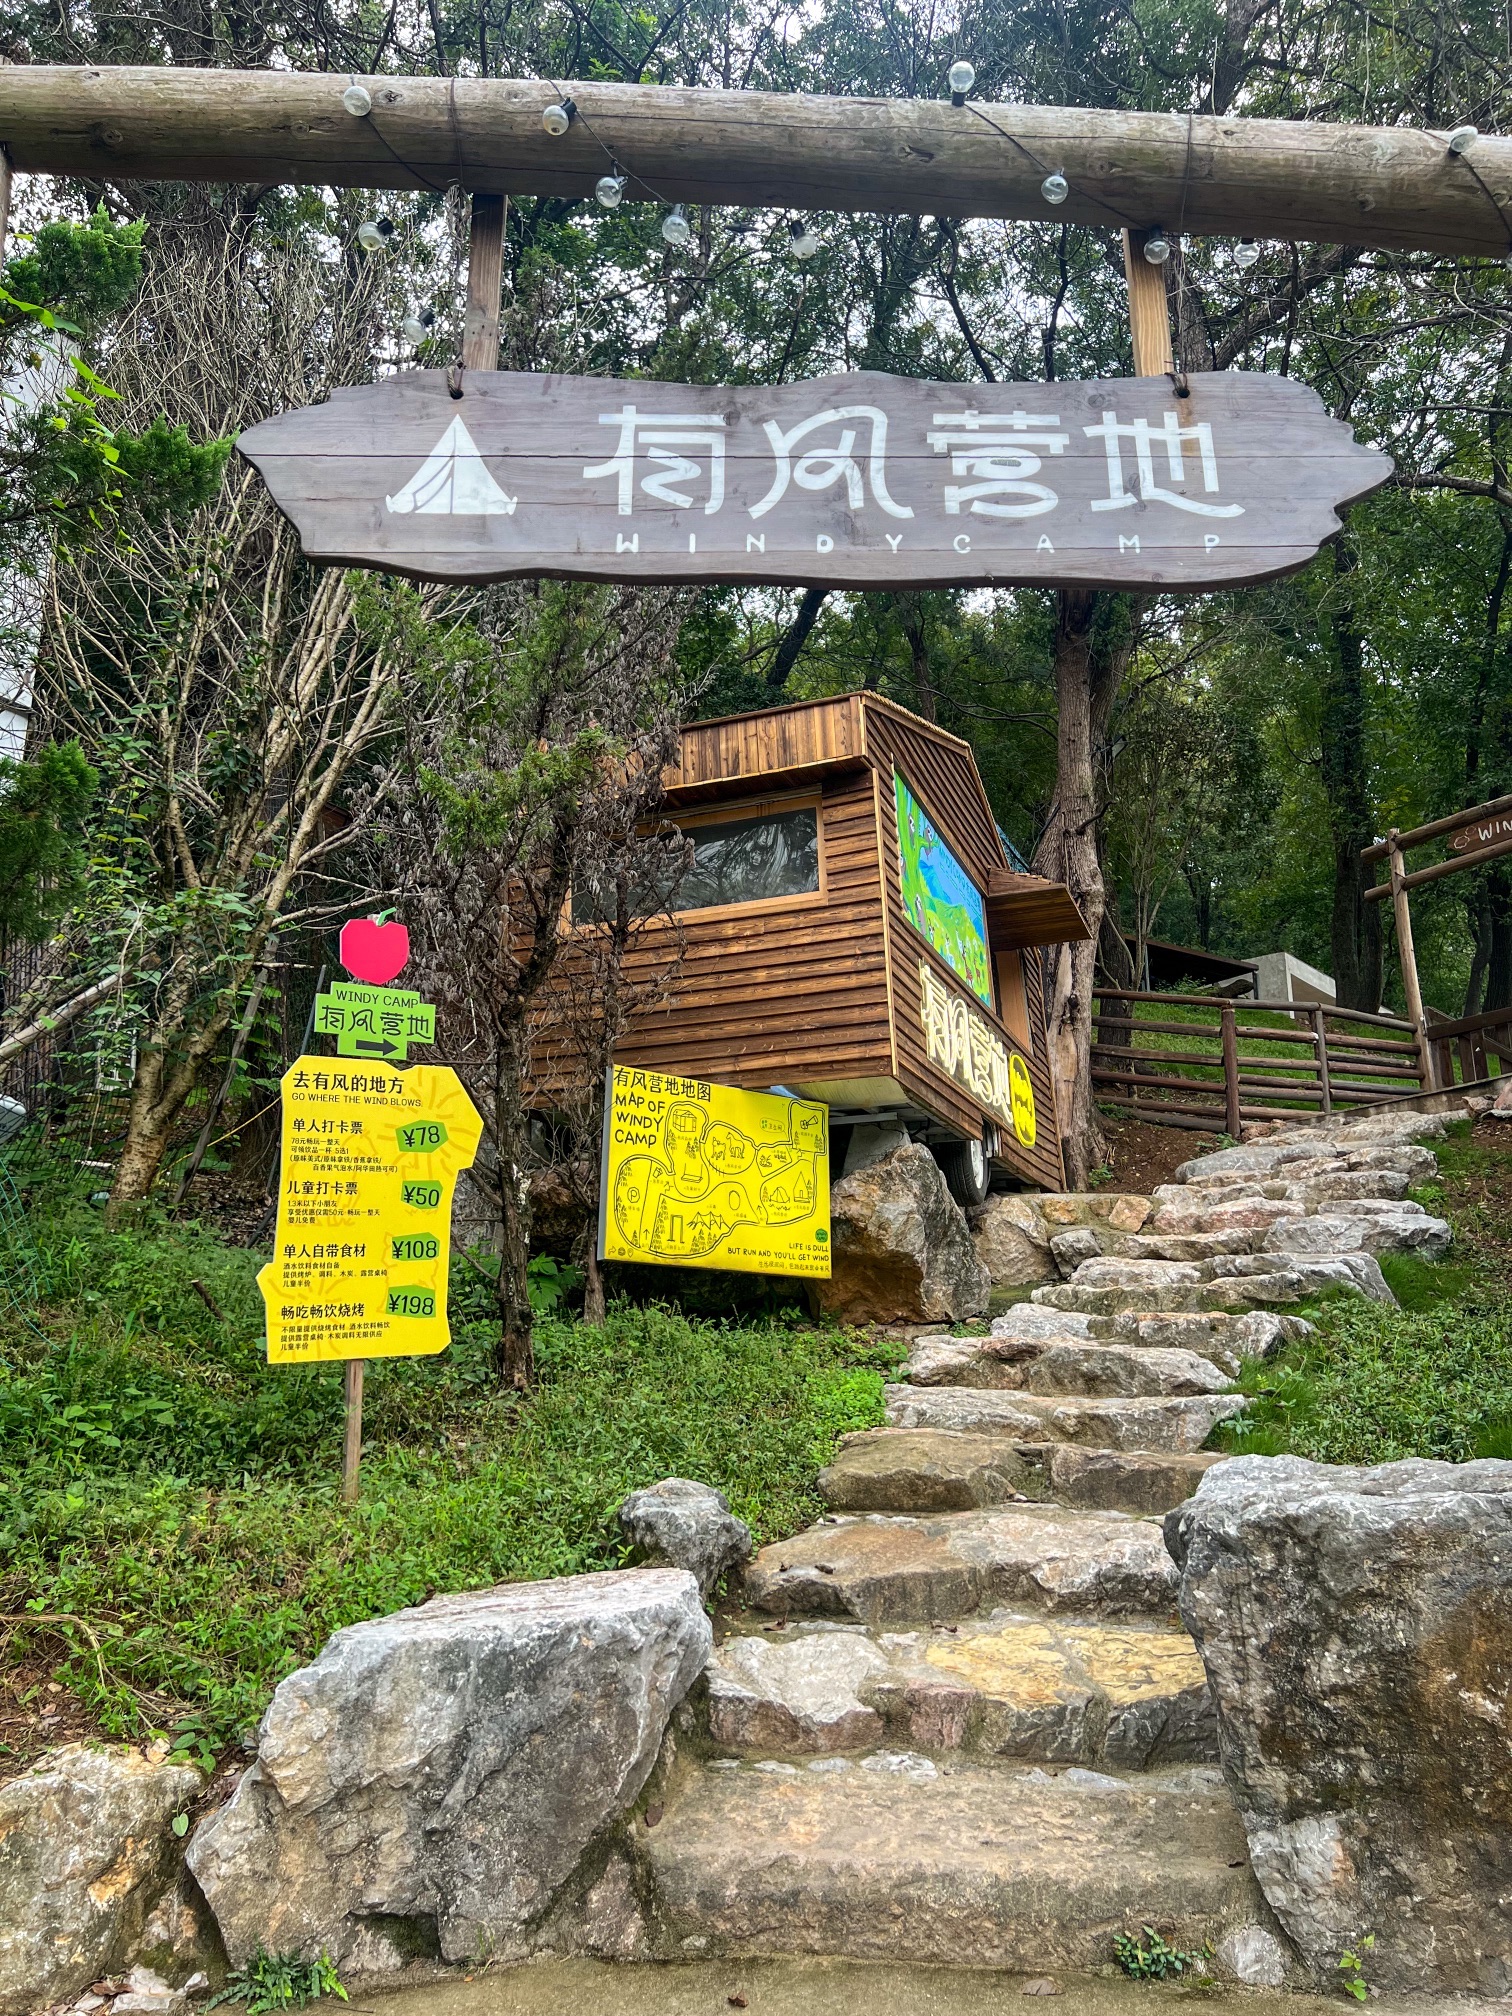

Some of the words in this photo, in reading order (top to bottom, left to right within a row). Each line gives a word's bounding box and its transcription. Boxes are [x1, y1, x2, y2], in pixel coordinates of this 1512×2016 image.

[583, 404, 1246, 520] 有风营地
[336, 989, 379, 1004] WINDY
[383, 995, 419, 1009] CAMP
[318, 1004, 432, 1040] 有风营地
[292, 1070, 405, 1094] 去有风的地方
[613, 1067, 711, 1103] 有风营地地图
[291, 1092, 305, 1101] GO
[308, 1093, 341, 1103] WHERE
[343, 1095, 361, 1104] THE
[363, 1096, 389, 1106] WIND
[615, 1091, 645, 1109] MAP
[648, 1100, 666, 1115] OF
[292, 1117, 364, 1135] 单人打卡票
[616, 1111, 664, 1132] WINDY
[290, 1137, 341, 1146] 78元畅玩一整天
[402, 1125, 441, 1148] ¥78
[614, 1128, 657, 1149] CAMP
[291, 1146, 333, 1155] 可领饮品一杯
[334, 1147, 349, 1155] 5选1
[286, 1180, 359, 1195] 儿童打卡票
[403, 1184, 440, 1207] ¥50
[287, 1216, 316, 1224] 婴儿免费
[283, 1243, 366, 1259] 单人自带食材
[392, 1240, 438, 1260] ¥108
[727, 1247, 741, 1255] BUT
[743, 1248, 757, 1256] RUN
[774, 1251, 796, 1260] YOU'LL
[812, 1254, 830, 1262] WIND
[789, 1242, 803, 1250] LIFE
[812, 1244, 829, 1253] DULL
[283, 1261, 340, 1270] 酒水饮料食材自备
[282, 1279, 311, 1288] 儿童半价
[281, 1302, 365, 1320] 畅吃畅饮烧烤
[388, 1293, 434, 1316] ¥198
[280, 1342, 309, 1351] 儿童半价
